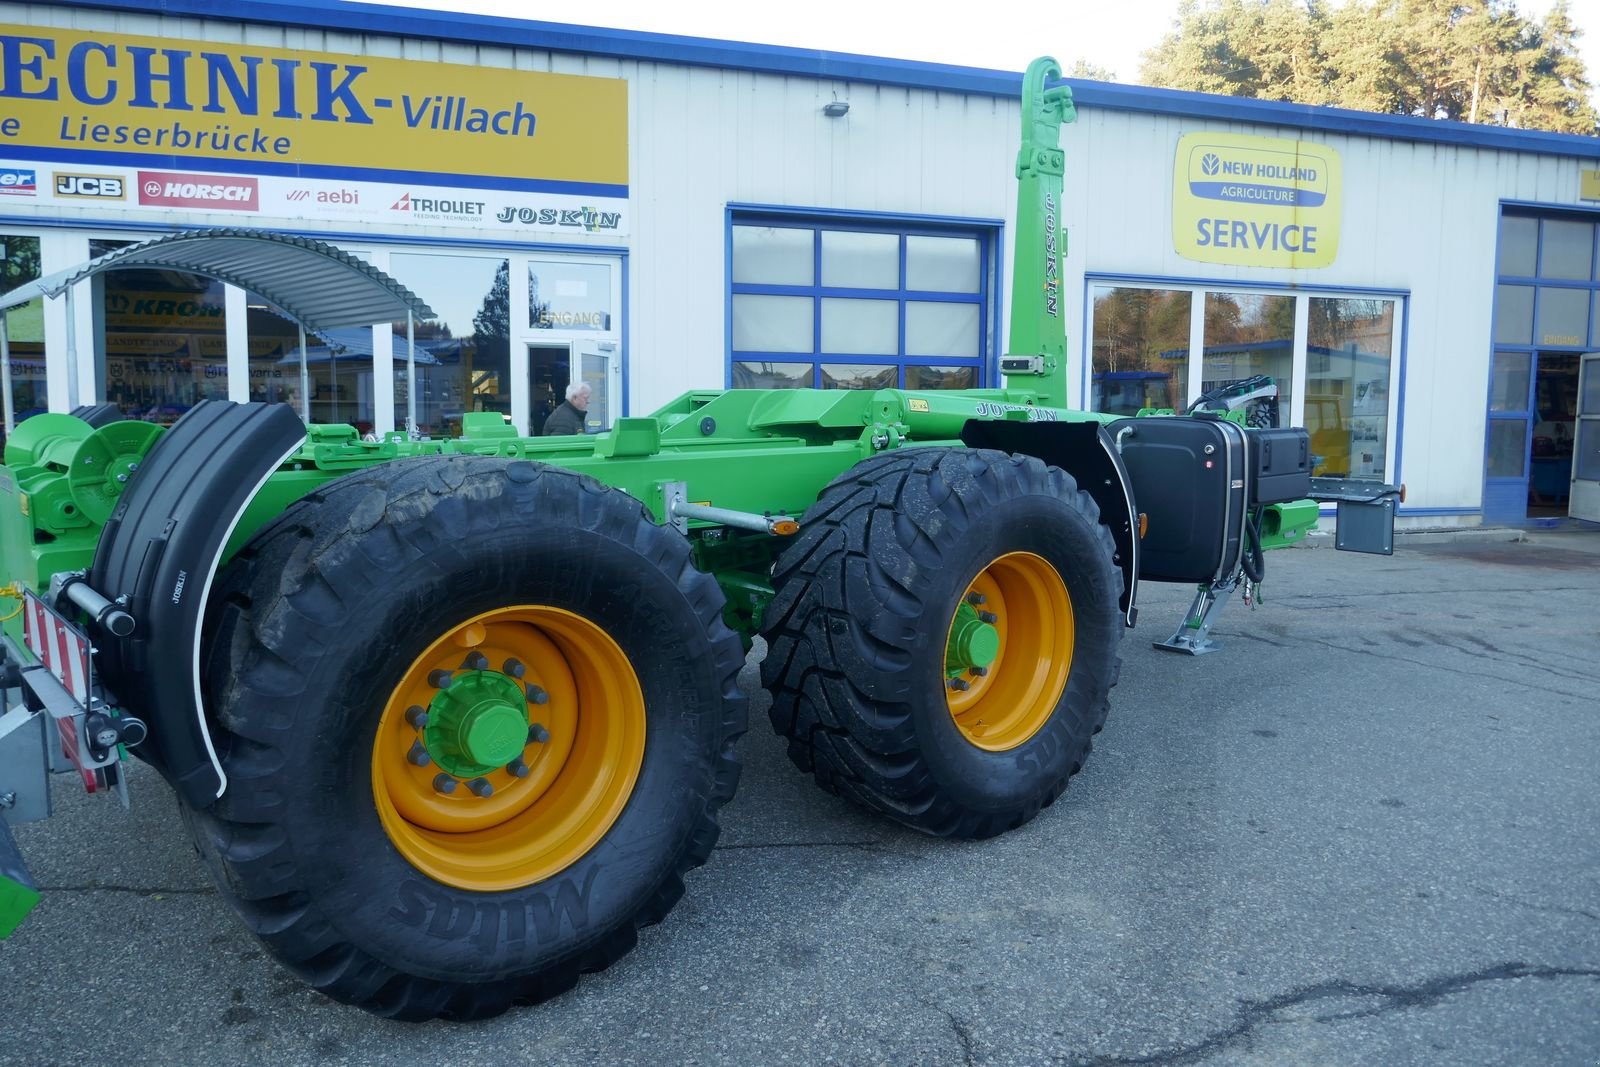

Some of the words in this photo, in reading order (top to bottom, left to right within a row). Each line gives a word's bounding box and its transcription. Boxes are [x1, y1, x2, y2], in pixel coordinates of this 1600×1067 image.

[60, 116, 291, 155] Lieserbrücke
[1222, 161, 1253, 176] NEW
[1256, 164, 1317, 182] HOLLAND
[58, 176, 122, 197] JCB
[163, 182, 252, 202] HORSCH
[316, 188, 359, 205] aebi
[1220, 186, 1295, 202] AGRICULTURE
[410, 198, 485, 215] TRIOLIET
[497, 206, 621, 231] JOSKIN
[1196, 218, 1318, 254] SERVICE
[1045, 193, 1057, 318] JOSKIN
[539, 310, 602, 326] EINGANG
[172, 569, 187, 604] JOSKIN
[387, 863, 602, 953] Mitas
